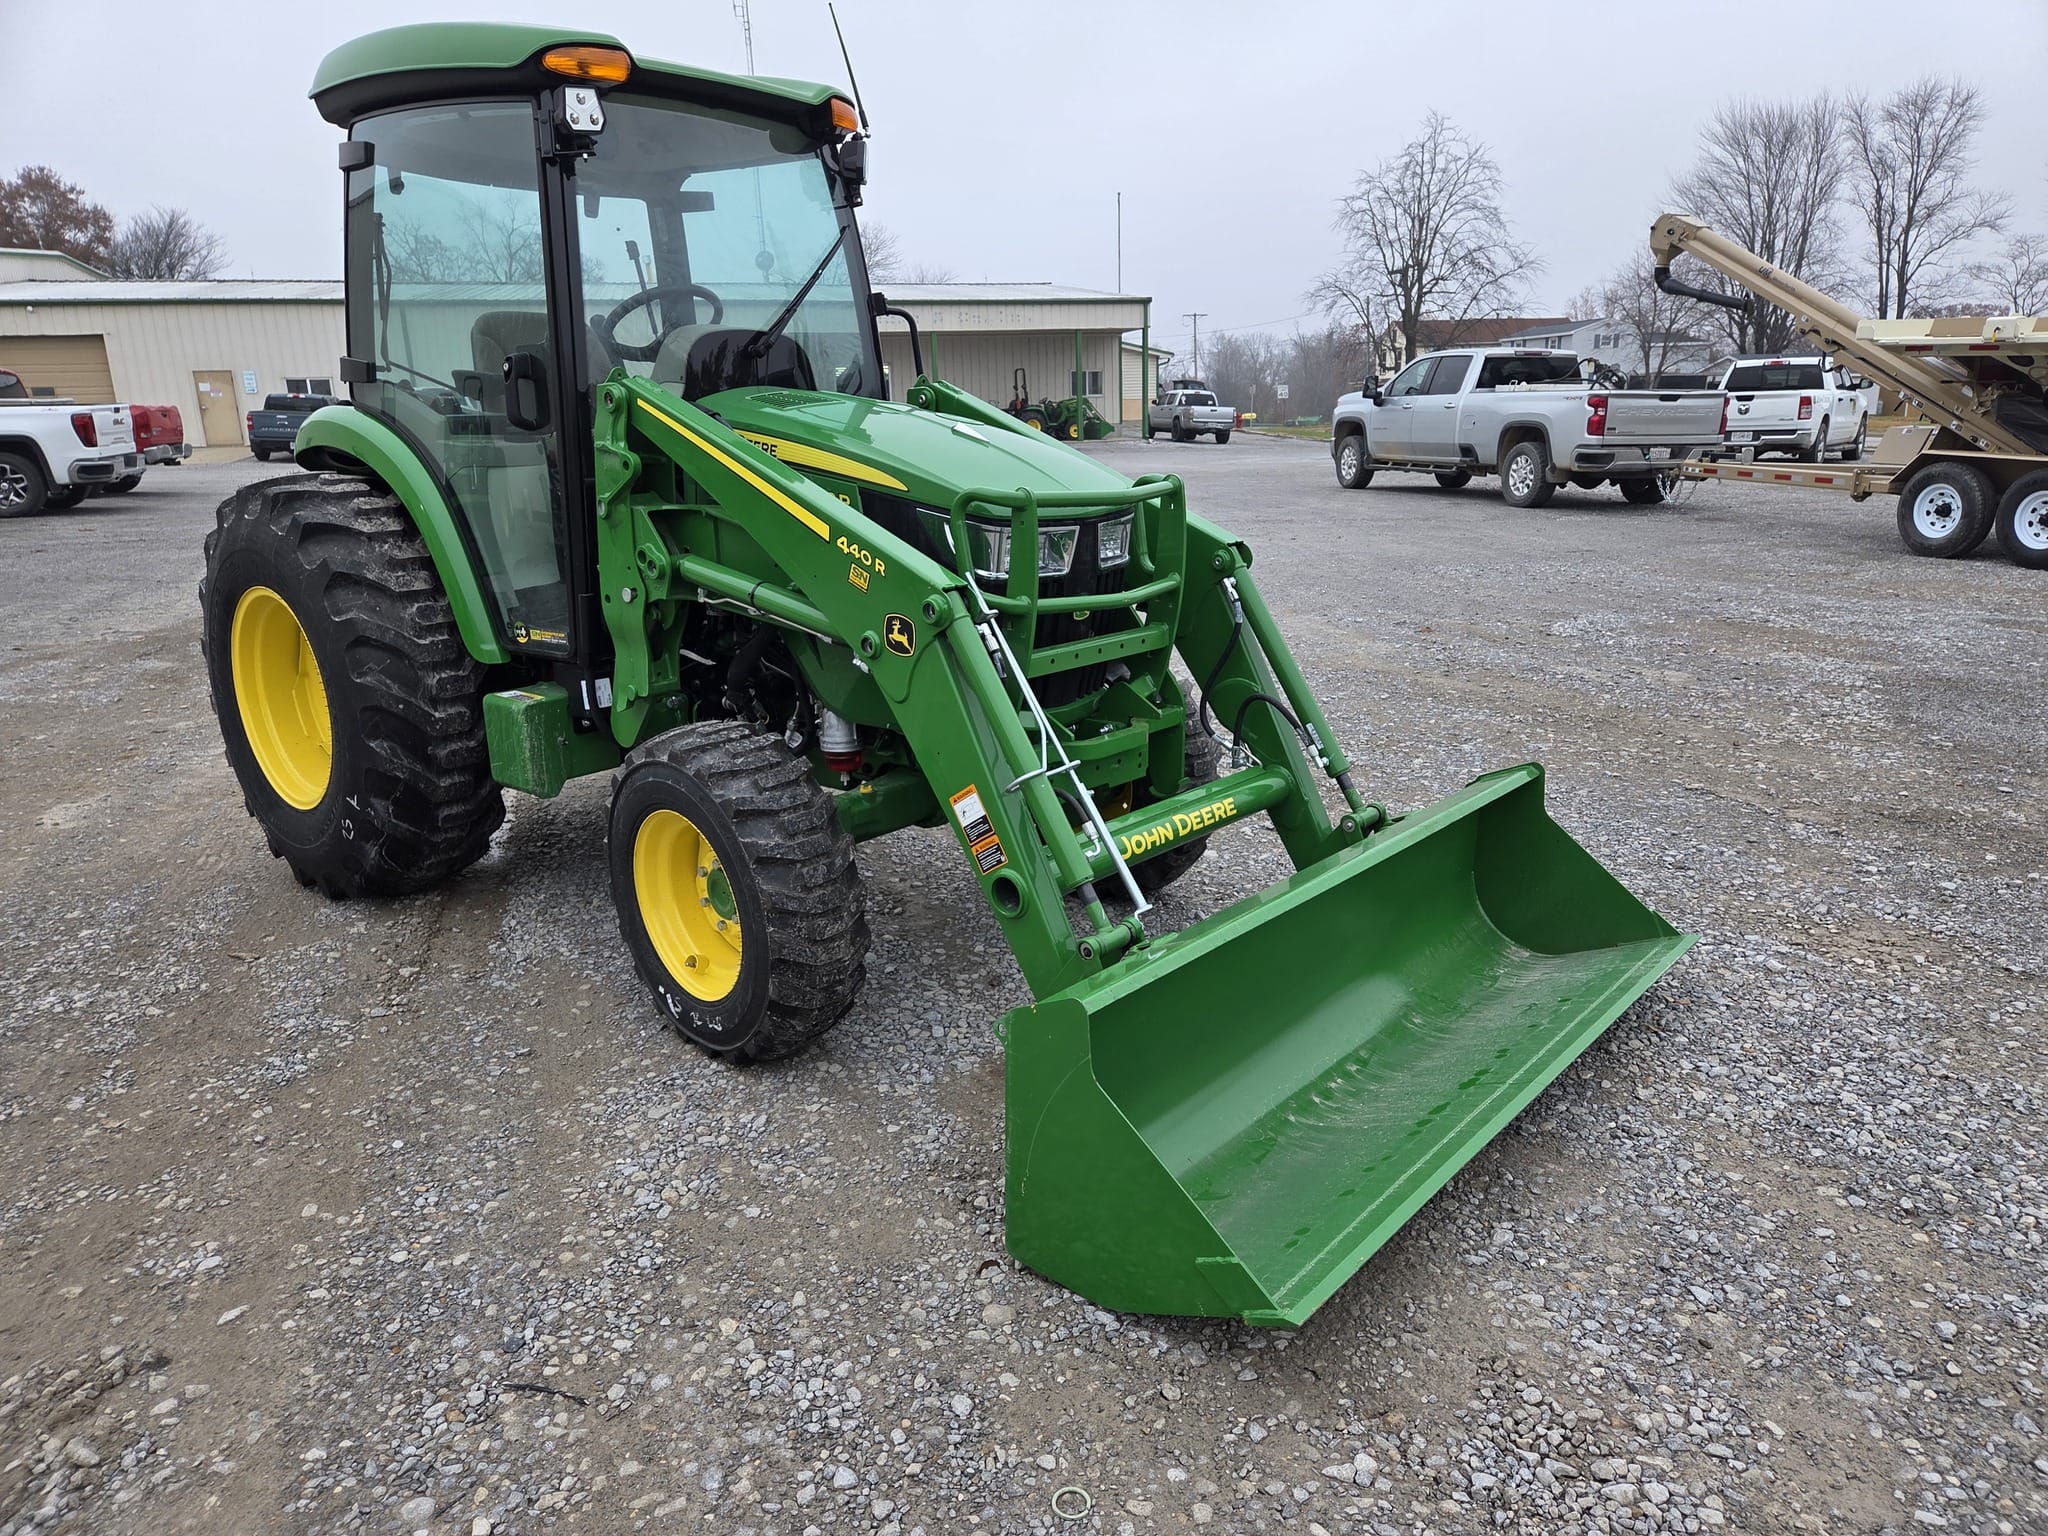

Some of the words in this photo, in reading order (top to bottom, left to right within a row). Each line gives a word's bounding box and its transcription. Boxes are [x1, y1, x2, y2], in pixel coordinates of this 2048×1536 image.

[1615, 407, 1717, 417] CHEVROLET
[836, 536, 872, 567] 440
[875, 557, 886, 577] R
[1120, 822, 1174, 861] JOHN
[1172, 797, 1237, 837] DEERE
